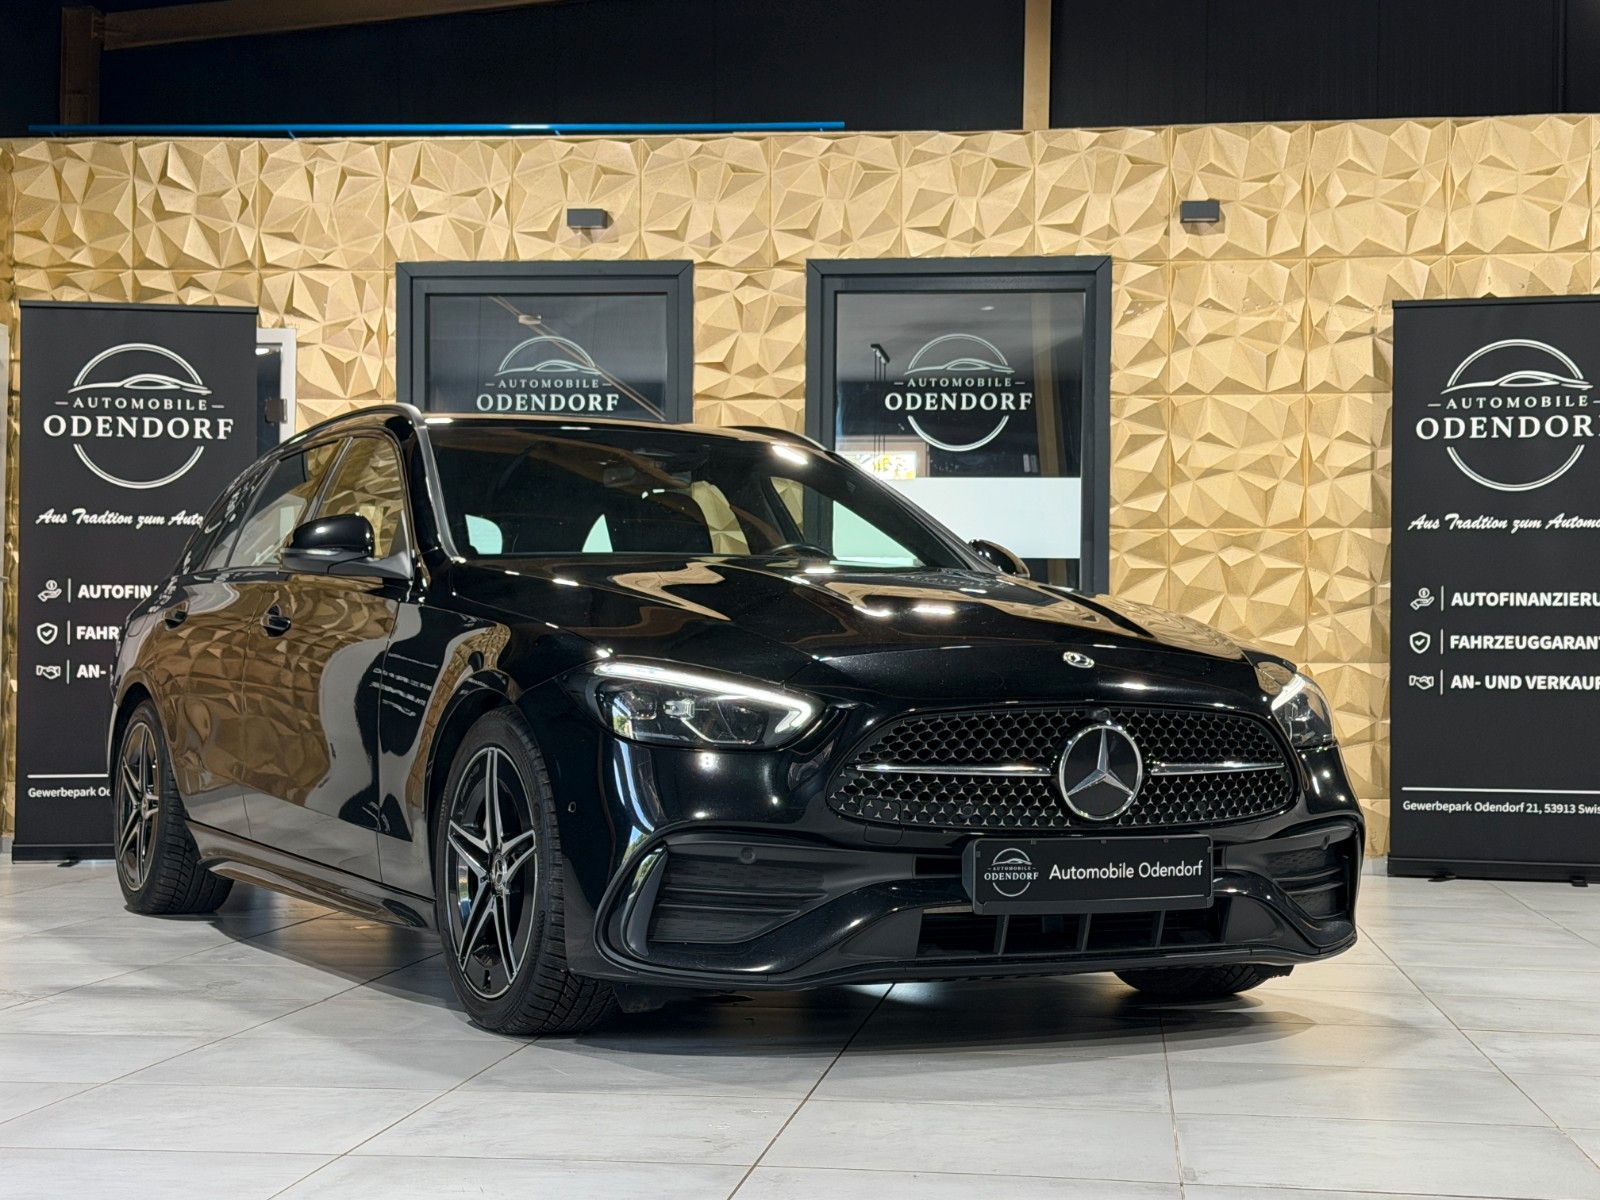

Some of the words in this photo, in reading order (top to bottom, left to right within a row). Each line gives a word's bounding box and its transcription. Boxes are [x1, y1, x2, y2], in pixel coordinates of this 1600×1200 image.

[498, 379, 599, 389] AUTOMOBILE
[908, 377, 1012, 387] AUTOMOBILE
[73, 397, 207, 411] AUTOMOBILE
[476, 393, 620, 411] ODENDORF
[884, 392, 1033, 411] ODENDORF
[1446, 395, 1588, 410] AUTOMOBILE
[43, 414, 234, 439] ODENDORF
[1415, 414, 1600, 440] ODENDOR
[36, 508, 67, 525] Aus
[135, 513, 165, 530] zum
[1407, 513, 1440, 531] Aus
[1444, 512, 1508, 531] Tradtion
[1511, 517, 1542, 535] zum
[77, 584, 159, 600] AUTOFIN
[76, 626, 122, 640] FAHR
[1449, 634, 1600, 650] FAHRZEUGGARAN
[76, 664, 107, 679] AN-
[1450, 674, 1482, 690] AN-
[1485, 674, 1523, 690] UND
[27, 786, 97, 799] Gewerbepark
[1402, 800, 1472, 814] Gewerbepark
[1474, 801, 1525, 813] Odendorf
[1526, 803, 1543, 815] 21,
[1544, 803, 1577, 814] 53913
[984, 872, 1039, 881] ODENDORF
[1048, 862, 1135, 880] Automobile
[1138, 859, 1204, 878] Odendorf
